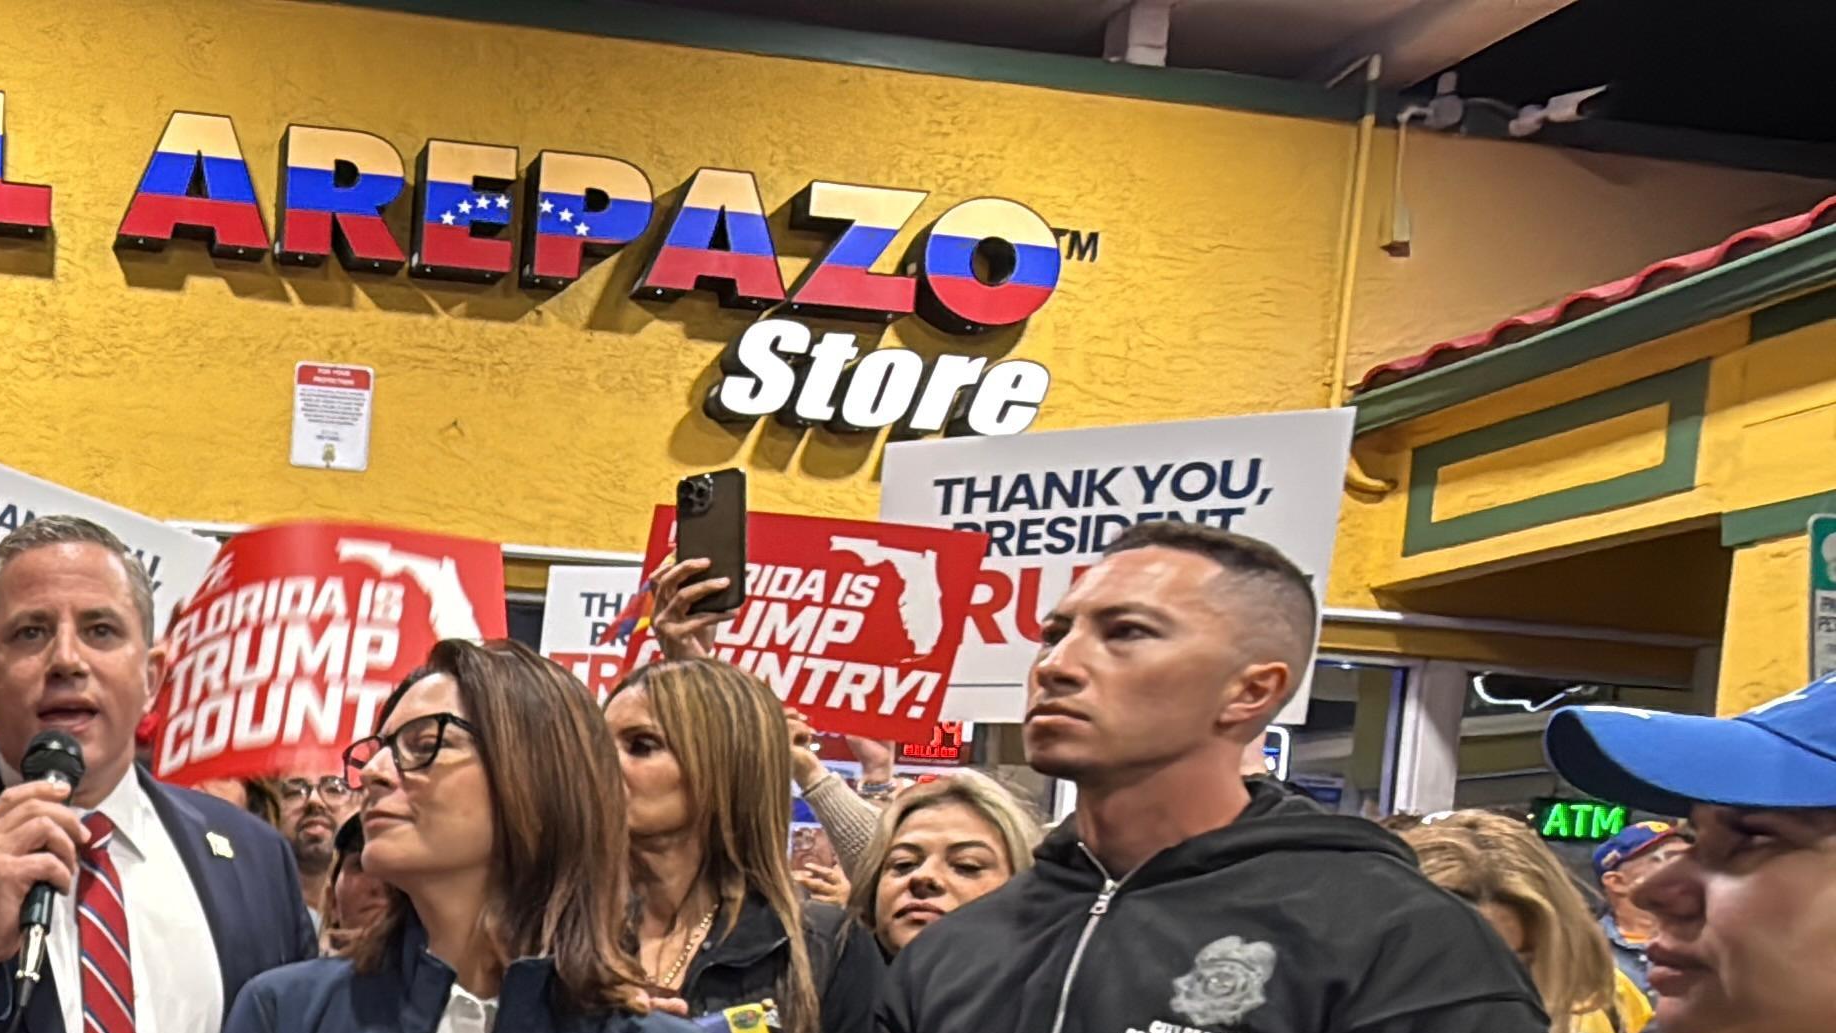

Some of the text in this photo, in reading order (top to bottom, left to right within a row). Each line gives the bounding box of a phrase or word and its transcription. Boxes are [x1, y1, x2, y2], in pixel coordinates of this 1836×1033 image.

[116, 109, 1061, 330] AREPAZO
[719, 319, 1051, 437] Store
[933, 457, 1273, 516] THANK YOU,
[952, 507, 1245, 558] RESIDT
[170, 575, 348, 663] FLORIDA
[831, 572, 880, 608] IS
[714, 599, 864, 655] UMP
[167, 618, 401, 717] TRUMP
[160, 677, 402, 776] COUNT
[1542, 801, 1627, 838] ATM
